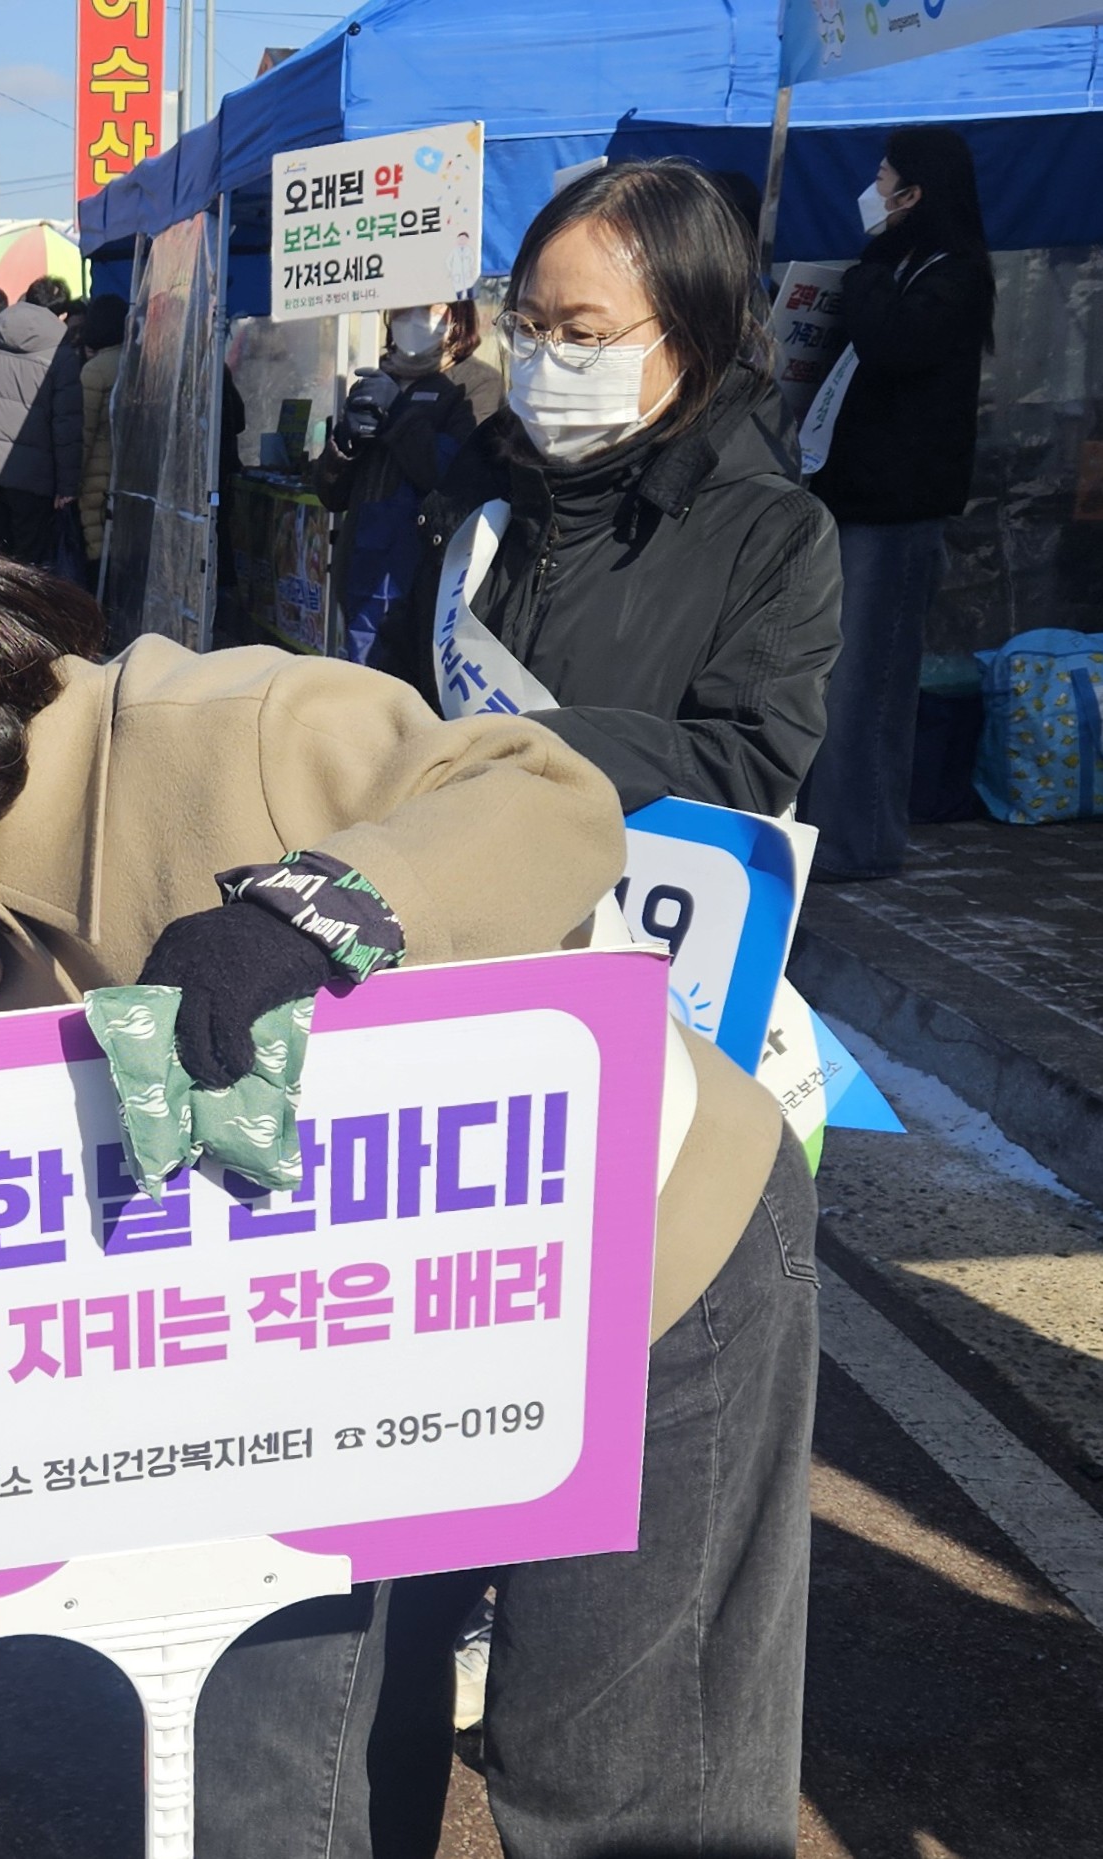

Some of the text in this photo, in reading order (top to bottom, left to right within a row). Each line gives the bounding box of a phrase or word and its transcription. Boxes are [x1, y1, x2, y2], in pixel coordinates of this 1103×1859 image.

[284, 163, 404, 216] 오래된 약
[284, 253, 385, 290] 가져오세요
[256, 867, 328, 901] LUCKY
[291, 903, 360, 945] LUCKY
[331, 934, 385, 982] LUCKY
[8, 1286, 231, 1384] 지키는
[247, 1261, 395, 1351] 작은
[414, 1240, 564, 1335] 배려
[43, 1428, 314, 1492] 정신건강복지센터
[375, 1400, 546, 1449] 395-0199
